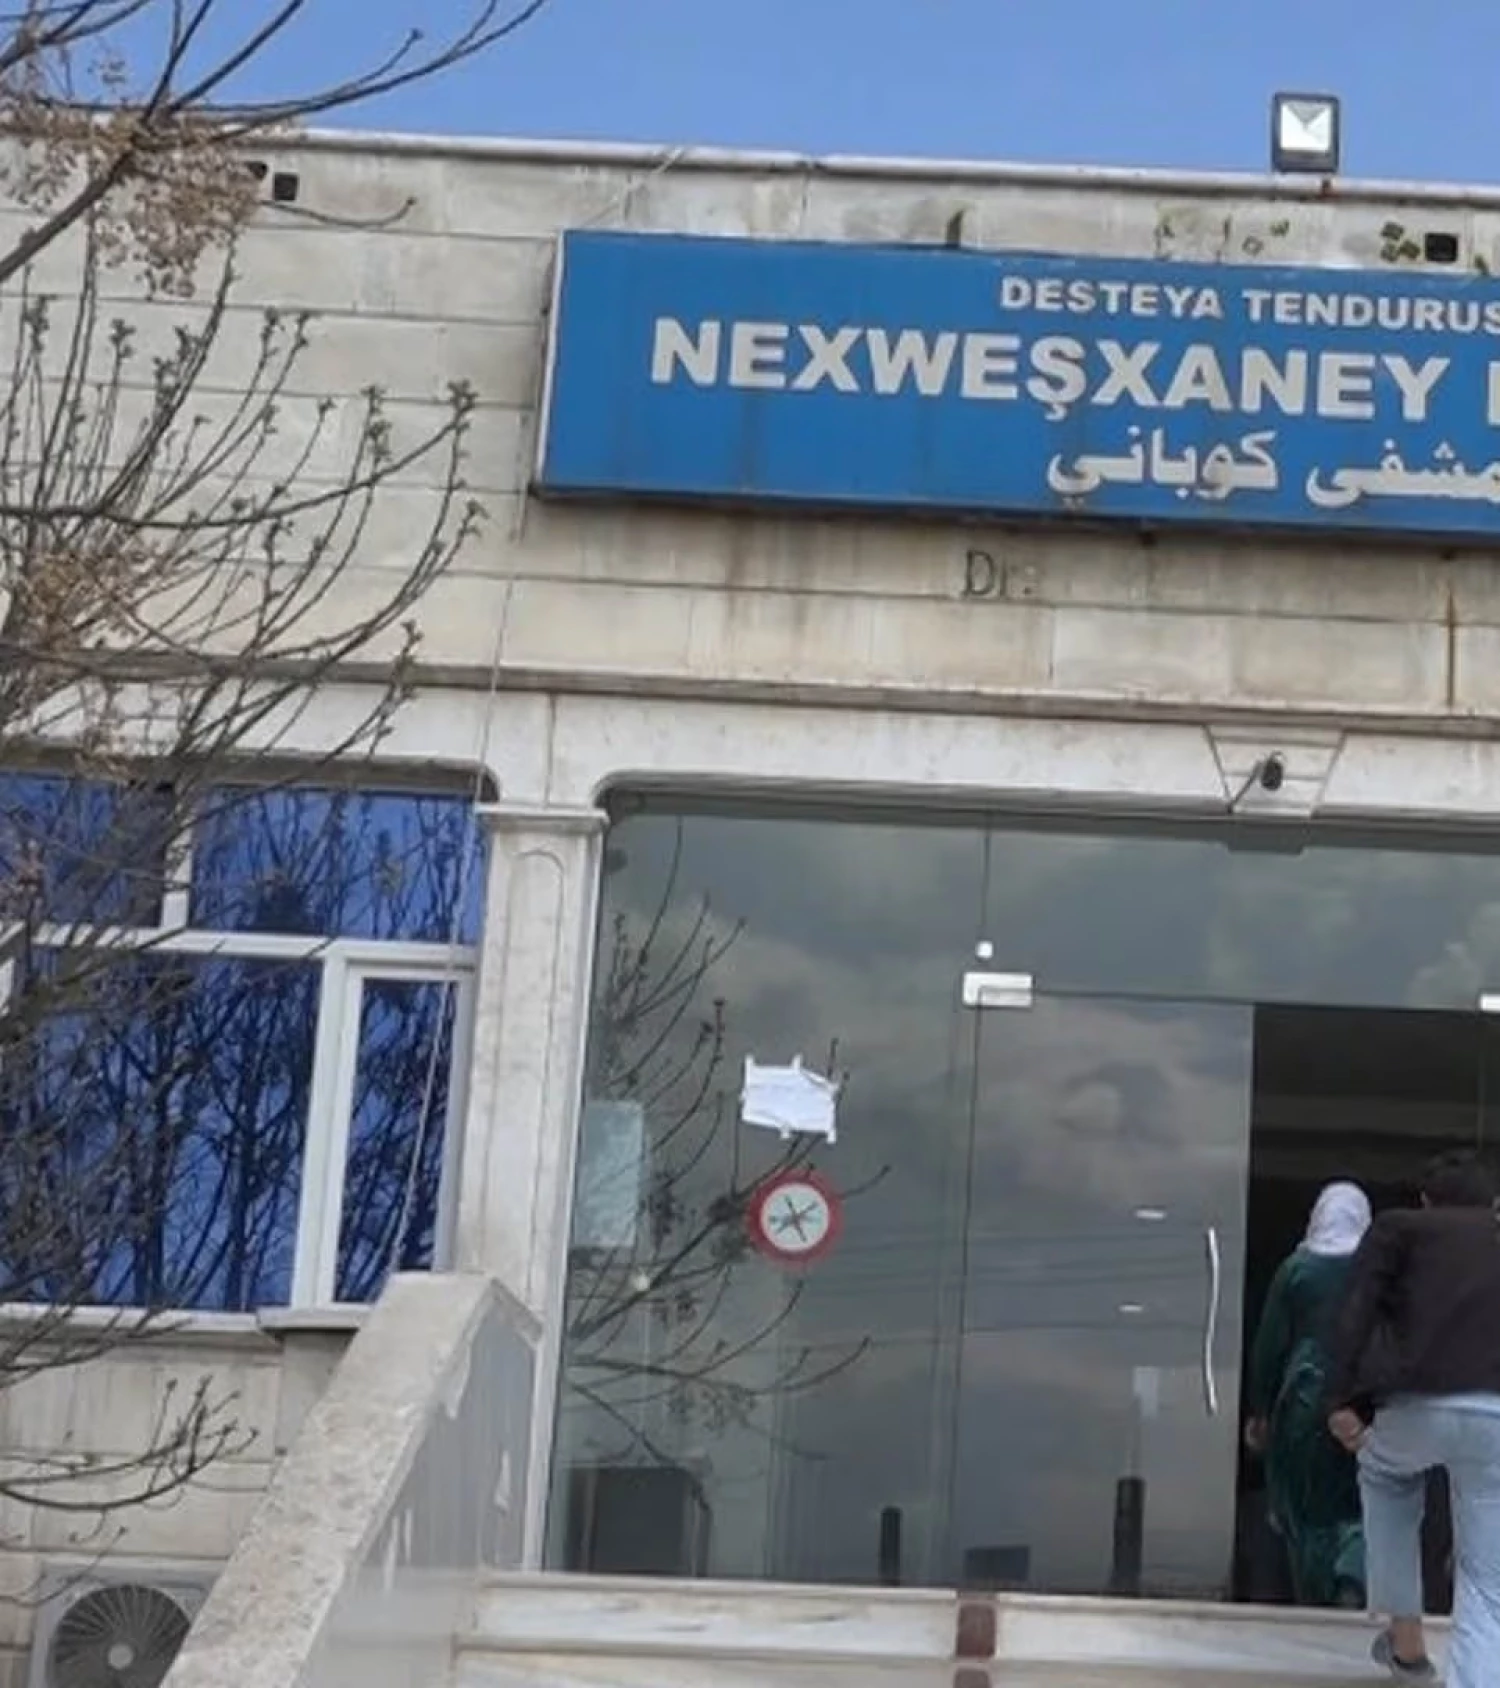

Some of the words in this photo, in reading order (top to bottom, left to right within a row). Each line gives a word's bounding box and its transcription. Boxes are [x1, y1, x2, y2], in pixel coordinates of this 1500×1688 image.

[1002, 277, 1222, 319] DESTEYA
[652, 318, 1450, 420] NEXWEŞXANEY
[1046, 425, 1280, 508] كوباني
